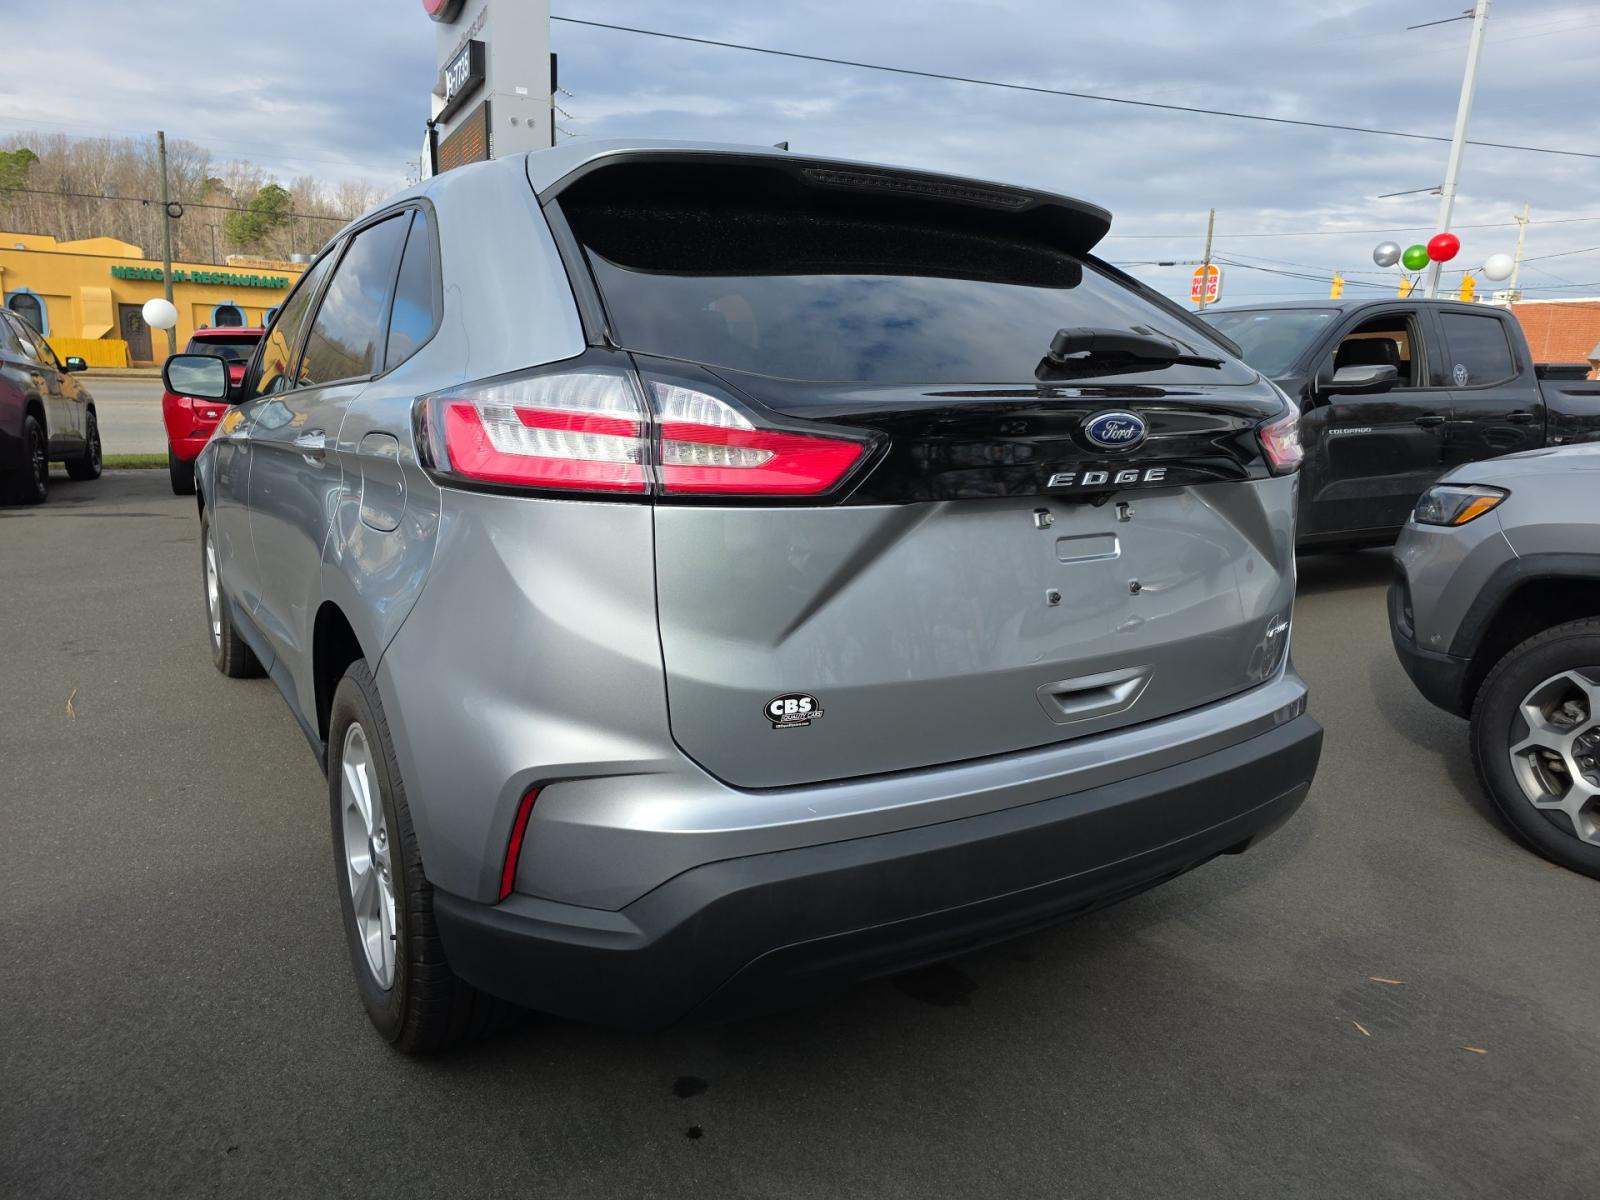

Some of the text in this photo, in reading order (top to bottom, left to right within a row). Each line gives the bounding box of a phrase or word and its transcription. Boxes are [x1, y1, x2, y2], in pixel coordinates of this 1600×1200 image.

[112, 266, 184, 281] MEXICN
[1102, 420, 1141, 440] Ford
[1328, 427, 1371, 435] COLORADO
[1046, 467, 1167, 488] EDGE
[770, 697, 812, 715] CBS
